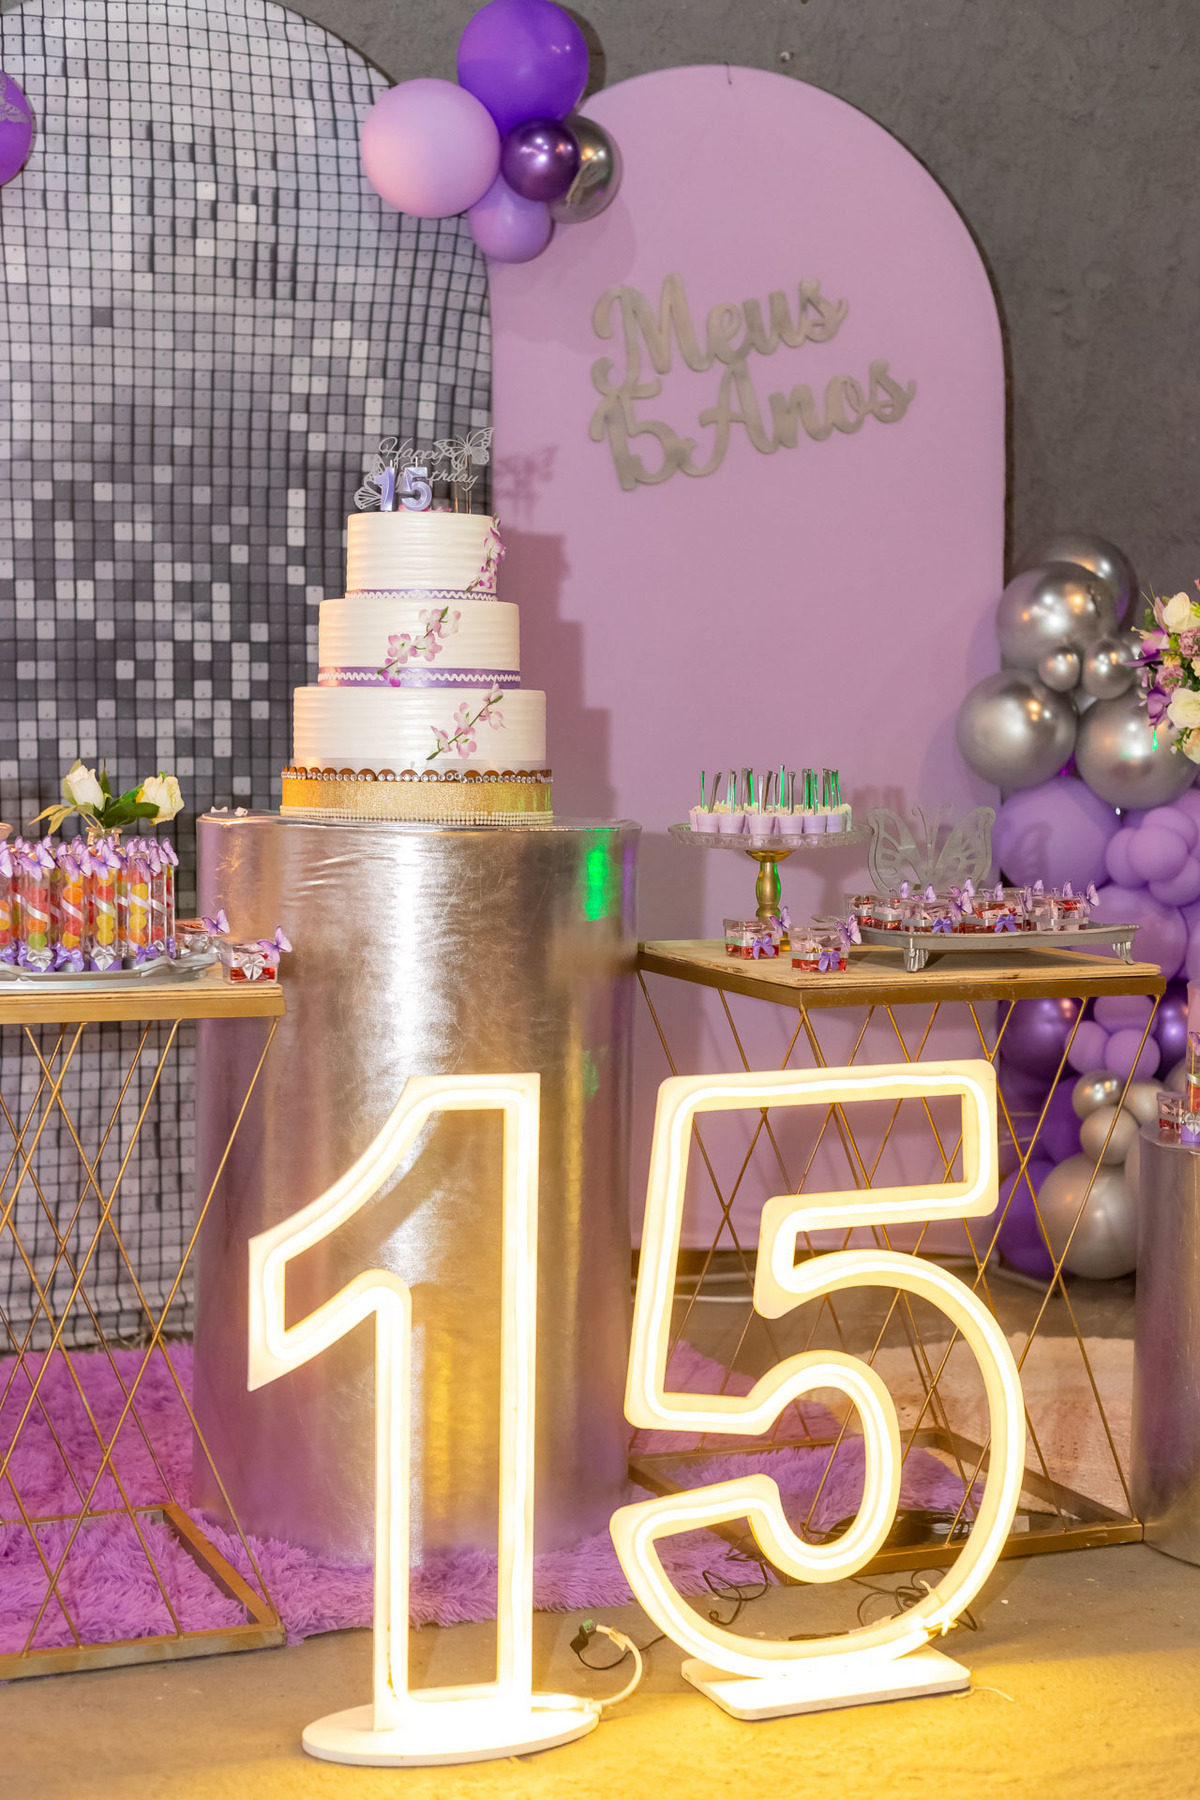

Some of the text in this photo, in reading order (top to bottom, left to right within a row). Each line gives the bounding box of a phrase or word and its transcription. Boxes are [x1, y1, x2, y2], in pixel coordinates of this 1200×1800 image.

[591, 273, 849, 396] Meus
[379, 436, 446, 466] Happy
[589, 358, 917, 492] 15 Anos
[374, 466, 433, 512] 15
[248, 1059, 1026, 1730] 15
